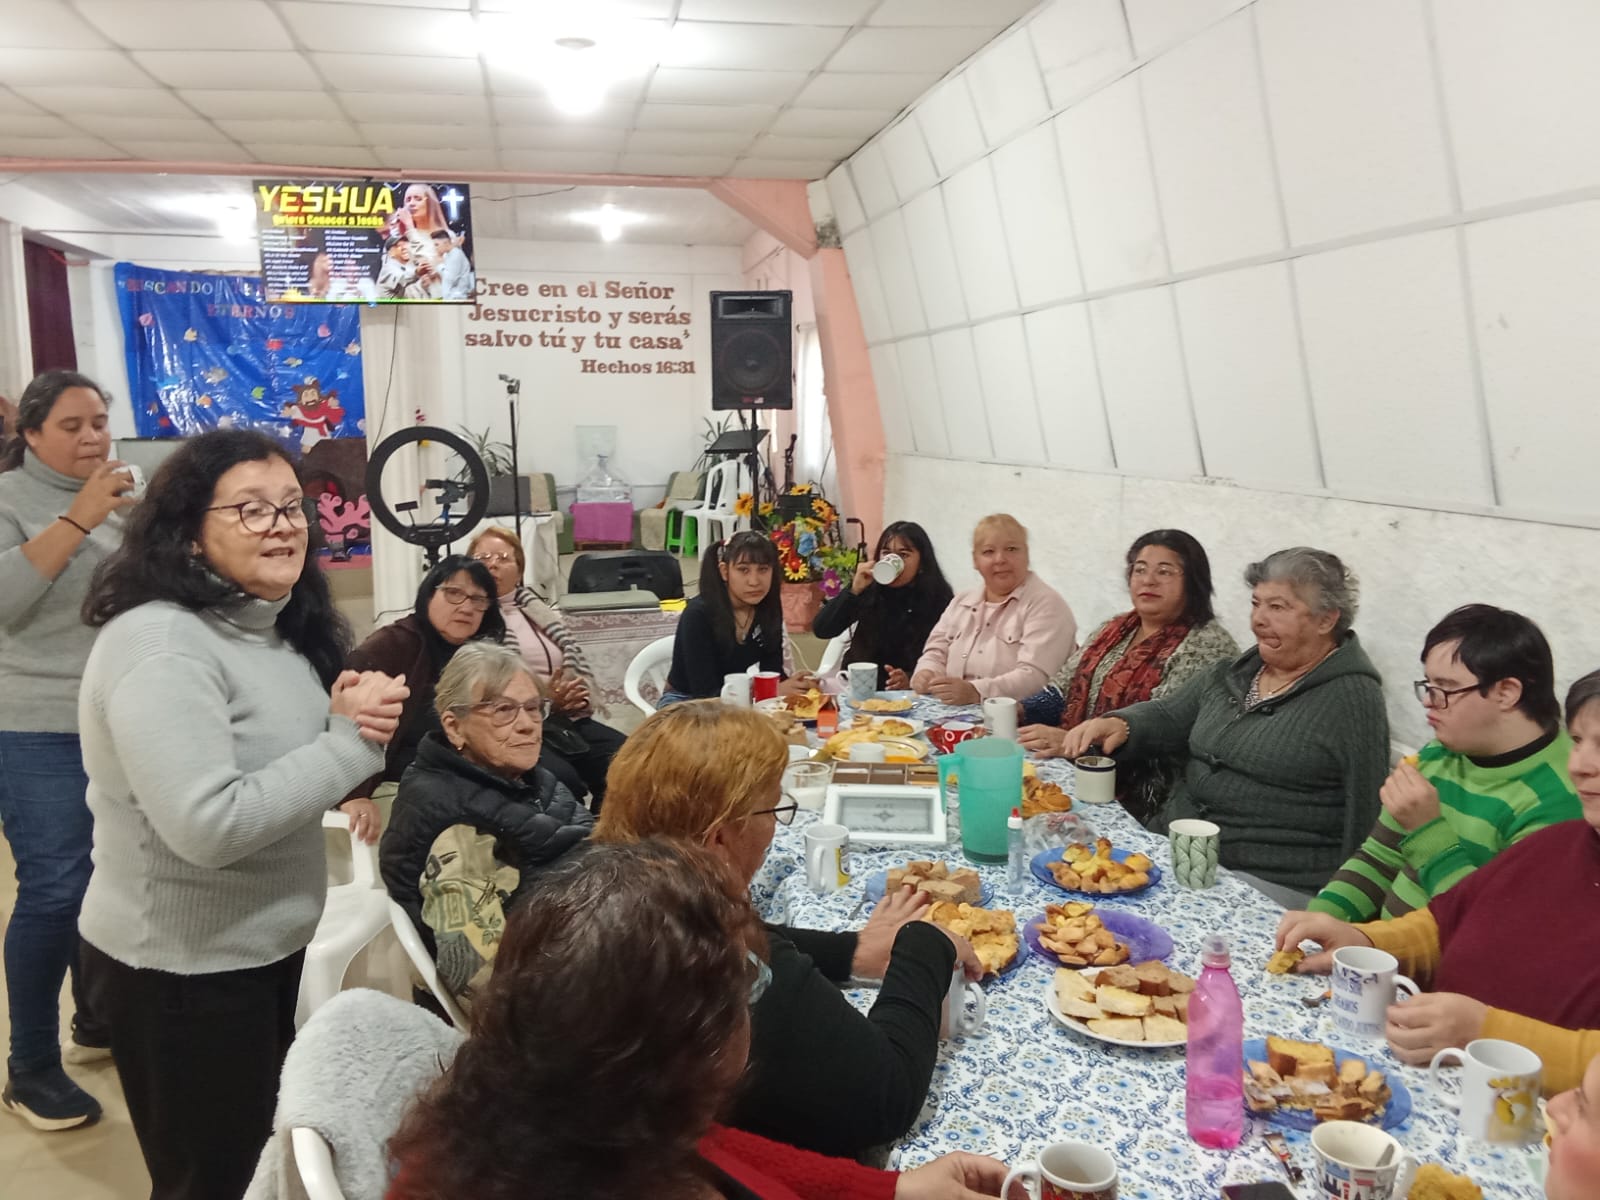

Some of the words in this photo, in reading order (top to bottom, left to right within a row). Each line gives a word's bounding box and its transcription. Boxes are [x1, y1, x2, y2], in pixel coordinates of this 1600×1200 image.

[259, 186, 393, 213] YESHUA
[475, 278, 529, 297] Cree
[538, 282, 567, 298] en
[577, 281, 598, 298] el
[605, 281, 674, 300] Señor
[468, 304, 601, 323] Jesucristo
[608, 311, 623, 329] y
[628, 306, 691, 325] serás
[465, 330, 533, 348] salvo
[539, 327, 567, 348] tú
[571, 334, 584, 353] y
[594, 332, 622, 349] tu
[581, 359, 653, 375] Hechos
[655, 360, 696, 375] 16:31
